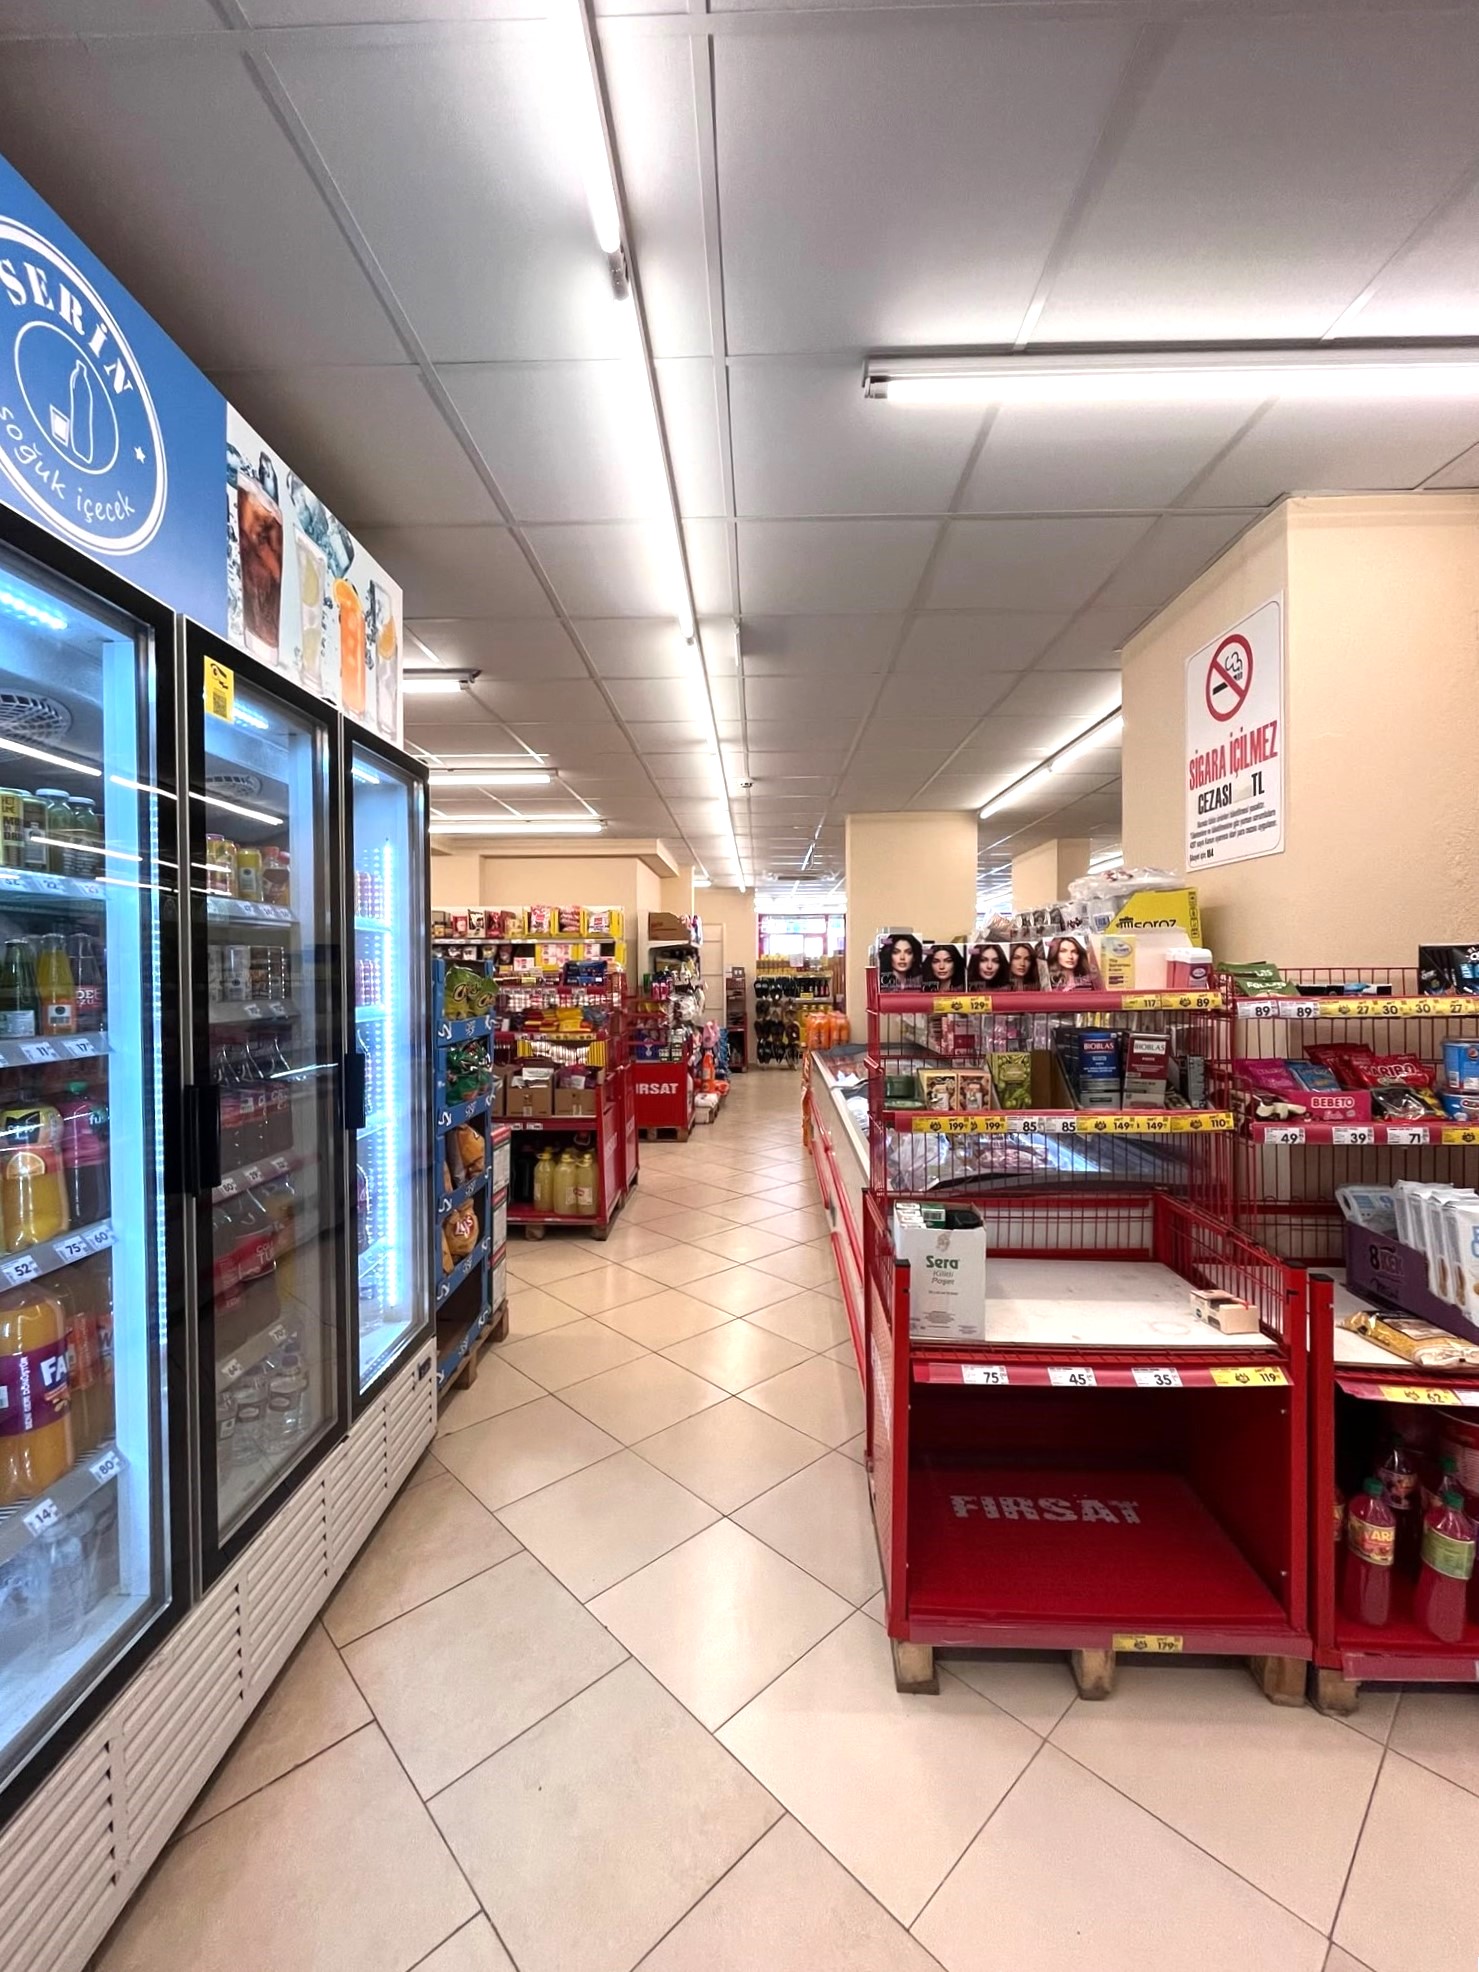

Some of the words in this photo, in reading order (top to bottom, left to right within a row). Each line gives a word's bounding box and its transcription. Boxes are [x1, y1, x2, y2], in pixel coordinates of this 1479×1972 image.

[0, 258, 133, 394] SERİN
[0, 406, 65, 500] soğuk
[76, 488, 135, 523] içecek
[1189, 748, 1227, 791] SİGARA
[1229, 720, 1278, 778] İÇİLMEZ
[1198, 782, 1232, 815] CEZASI
[1251, 771, 1265, 797] TL
[970, 1002, 985, 1010] 129
[1143, 999, 1156, 1007] 117
[1196, 998, 1210, 1007] 89
[1255, 1006, 1270, 1017] 89
[1296, 1007, 1312, 1018] 89
[1357, 1005, 1370, 1015] 27
[1383, 1005, 1398, 1015] 30
[1415, 1003, 1431, 1014] 30
[1450, 1004, 1462, 1014] 27
[1083, 1042, 1115, 1051] BIOBLAS
[1134, 1043, 1165, 1052] BIOBLAS
[1311, 1097, 1355, 1109] BEBETO
[949, 1122, 964, 1131] 199
[985, 1122, 1000, 1131] 199
[1022, 1121, 1037, 1132] 85
[1061, 1121, 1076, 1132] 85
[1113, 1121, 1130, 1130] 149
[1147, 1121, 1163, 1130] 149
[1211, 1119, 1226, 1128] 110
[1281, 1133, 1298, 1144] 49
[1350, 1133, 1366, 1144] 39
[1409, 1133, 1421, 1144] 71
[94, 1231, 109, 1244] 60
[66, 1243, 81, 1255] 75
[926, 1255, 959, 1270] Sera
[15, 1263, 32, 1277] 52
[983, 1371, 999, 1384] 75
[1068, 1373, 1087, 1386] 45
[1153, 1373, 1172, 1386] 35
[1259, 1372, 1277, 1383] 119
[100, 1461, 115, 1474] 80
[950, 1495, 1141, 1524] FIRSAT
[35, 1508, 51, 1524] 14
[1157, 1641, 1174, 1651] 179
